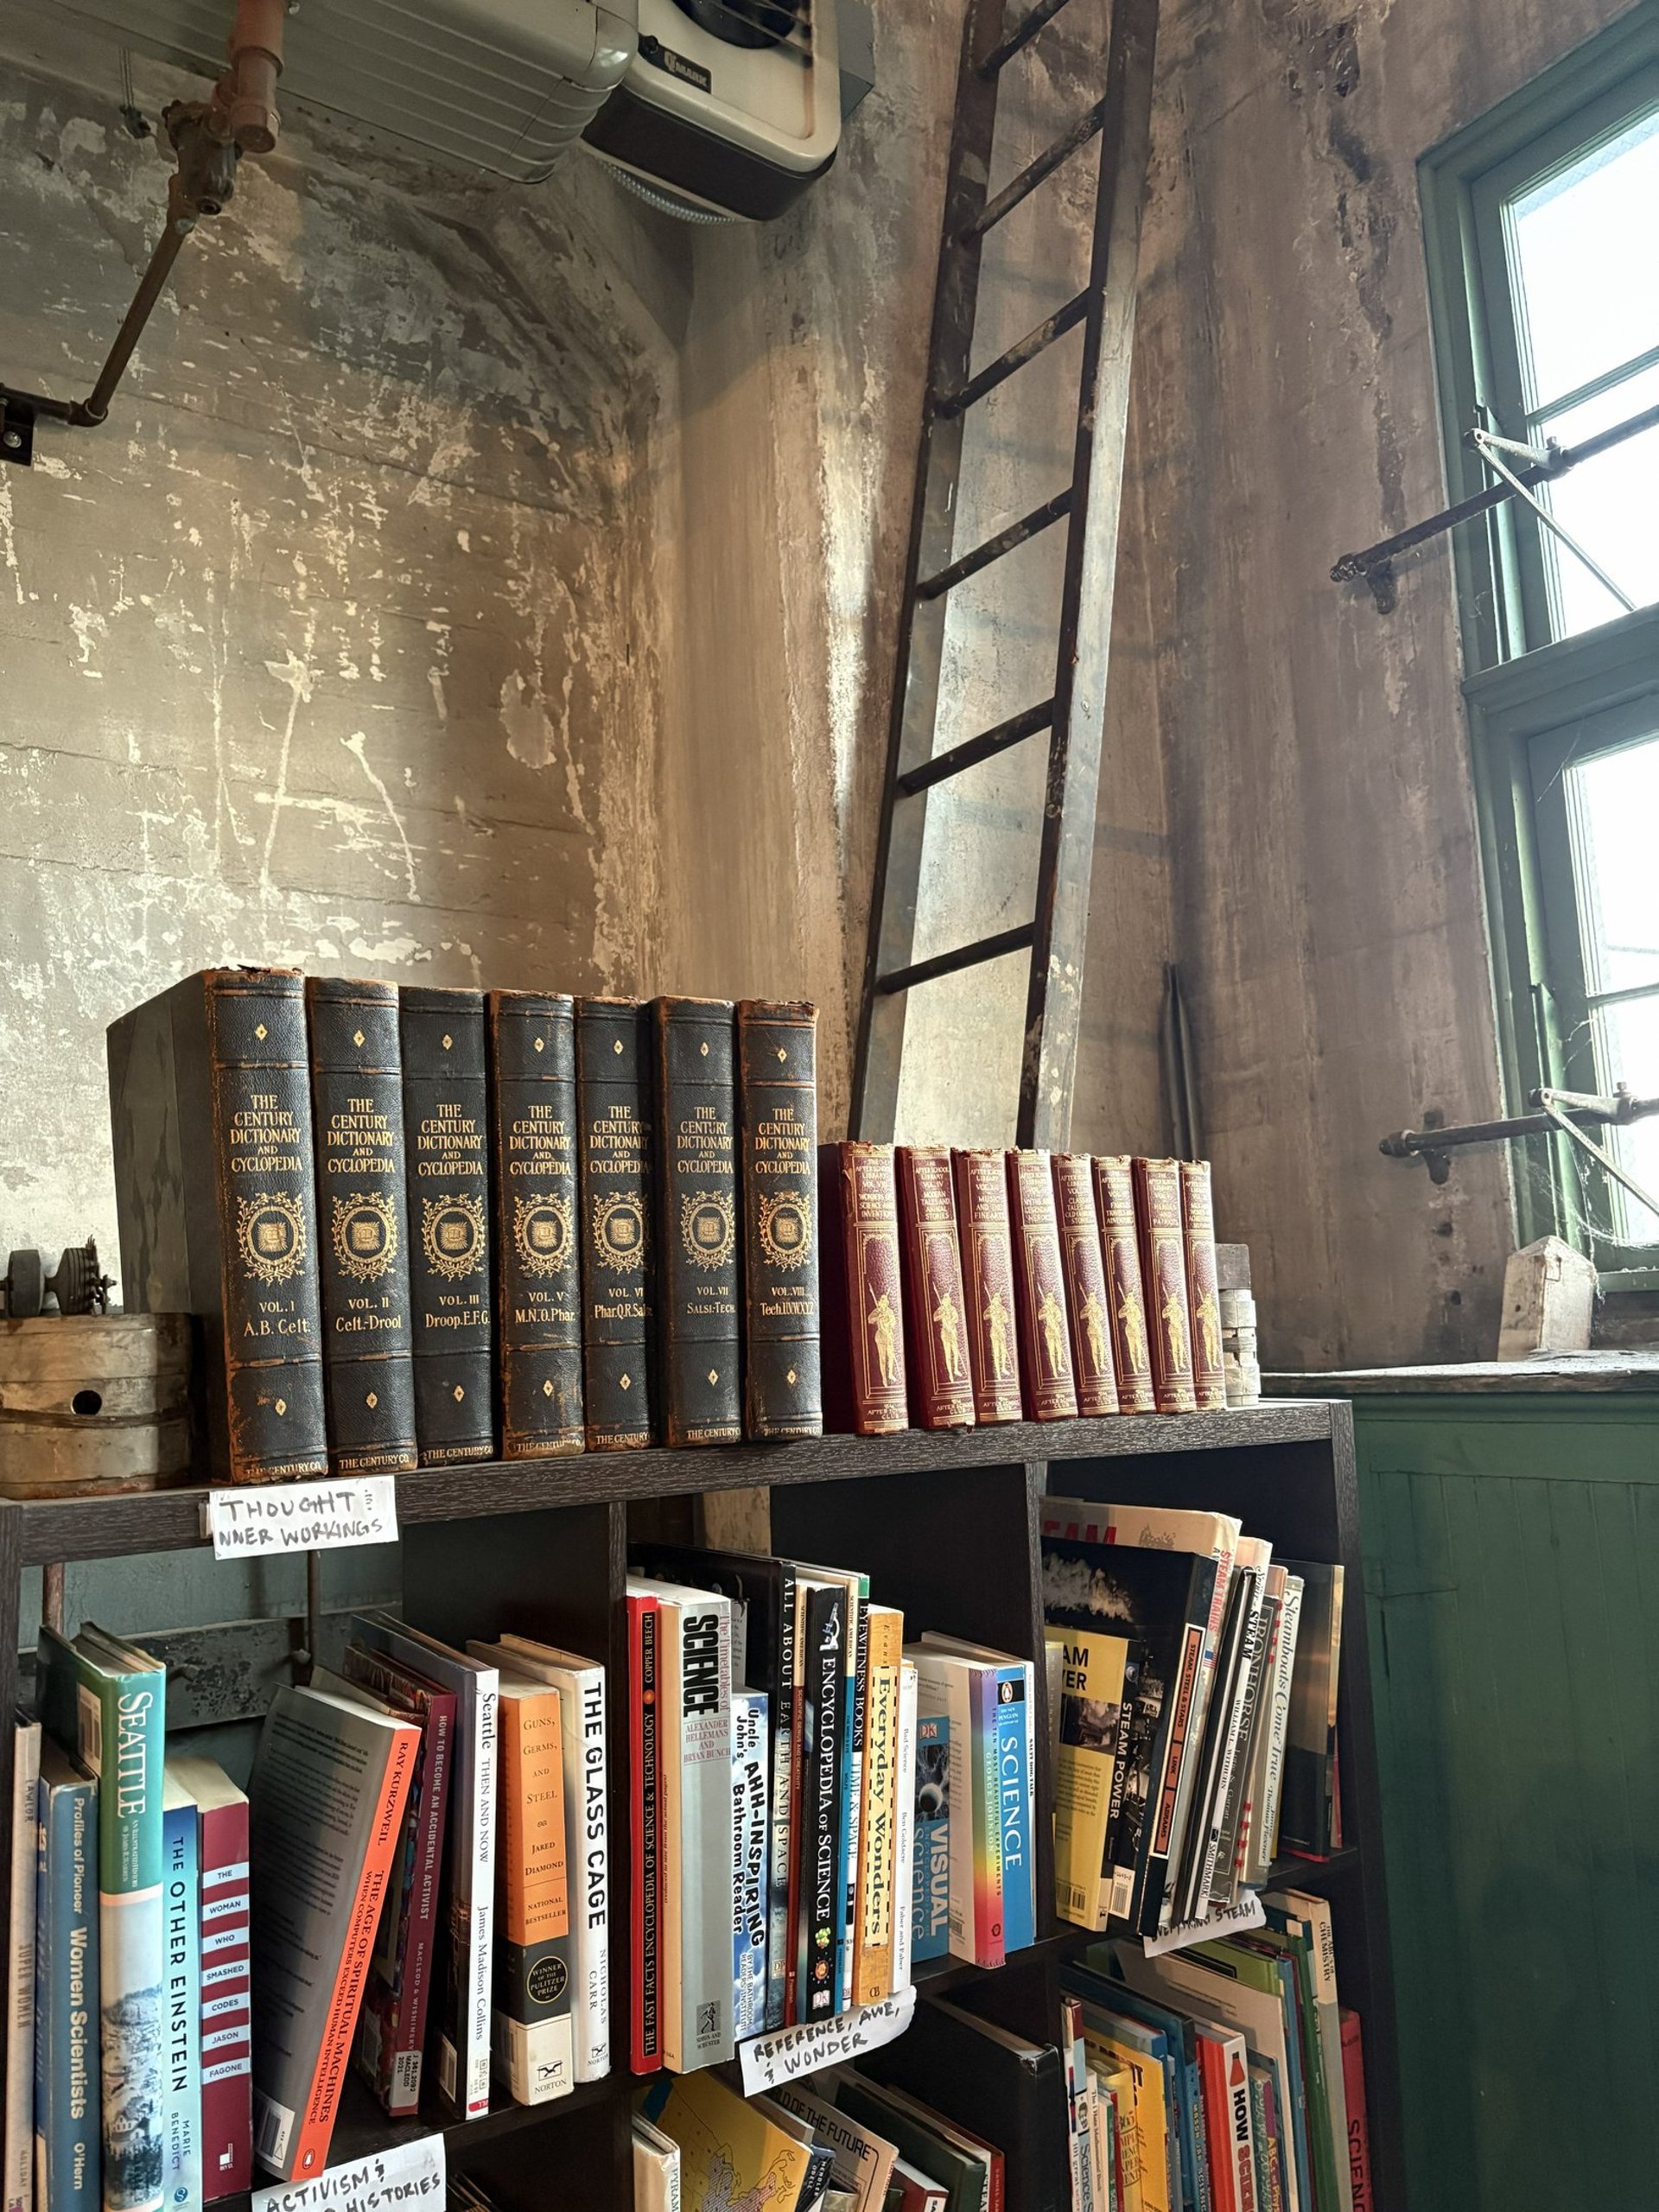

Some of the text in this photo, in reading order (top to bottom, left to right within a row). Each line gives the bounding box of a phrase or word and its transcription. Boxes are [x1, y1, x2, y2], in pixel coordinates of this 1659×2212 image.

[251, 1095, 278, 1109] THE
[347, 1099, 374, 1113] THE
[436, 1104, 461, 1118] THE
[529, 1105, 552, 1120] THE
[772, 1108, 794, 1121] THE
[234, 1111, 294, 1127] CENTURY
[331, 1114, 388, 1128] CENTURY
[421, 1119, 476, 1134] CENTURY
[513, 1121, 565, 1135] CENTURY
[758, 1122, 805, 1135] CENTURY
[230, 1128, 301, 1145] DICTIONARY
[327, 1130, 394, 1146] DICTIONARY
[416, 1135, 482, 1150] DICTIONARY
[509, 1135, 571, 1149] DICTIONARY
[755, 1136, 810, 1150] DICTIONARY
[257, 1145, 277, 1156] AND
[353, 1147, 373, 1156] AND
[442, 1151, 461, 1160] AND
[231, 1156, 303, 1173] CYCLOPEDIA
[327, 1157, 395, 1173] CYCLOPEDIA
[417, 1160, 483, 1176] CYCLOPEDIA
[509, 1160, 571, 1175] CYCLOPEDIA
[755, 1160, 810, 1175] CYCLOPEDIA
[219, 1491, 355, 1522] THOUGHT
[280, 1518, 383, 1547] WORKINGS
[1208, 1548, 1231, 1633] STEAM TRAINS
[1242, 1609, 1260, 1660] STEAM
[645, 1614, 653, 1683] COPPER BEECH
[683, 1613, 719, 1719] SCIENCE
[719, 1612, 731, 1713] The Timetables of
[854, 1605, 868, 1748] EYEWITNESS BOOKS
[1268, 1591, 1300, 1781] Steamboats Come True
[523, 1718, 556, 1731] GUNS,
[684, 1719, 728, 1733] ALEXANDER
[685, 1728, 728, 1744] HELLEMANS
[736, 1715, 747, 1758] John's
[747, 1708, 760, 1748] Uncle
[774, 1578, 794, 1888] ALL ABOUT EARTH AND SPACE
[117, 1691, 154, 1819] SEATTLE
[523, 1744, 557, 1756] GERMS,
[645, 1713, 654, 1788] TECHNOLOGY
[683, 1747, 731, 1763] BRYAN BUNCH
[698, 1740, 715, 1751] AND
[532, 1768, 550, 1777] AND
[1109, 1701, 1132, 1819] STEAM POWER
[1170, 1756, 1179, 1774] LINK
[480, 1693, 497, 1863] Seattle THEN AND NOW
[816, 1657, 836, 1922] ENCYCLOPEDIA OF SCIENCE
[378, 1742, 408, 1846] RAY KURZWEIL
[526, 1791, 557, 1805] STEEL
[584, 1682, 606, 1929] THE GLASS CAGE
[871, 1678, 890, 1934] Everyday Wonders
[1001, 1736, 1022, 1871] SCIENCE
[420, 1715, 448, 1920] HOW TO BECOME AN ACCIDENTAL ACTIVIST
[645, 1802, 654, 1852] SCIENCE
[1160, 1802, 1170, 1838] ABRAMS
[531, 1841, 556, 1854] JARED
[733, 1783, 747, 1934] Bathroom Reader
[744, 1760, 766, 1948] AHH-INSPIRING
[217, 1869, 232, 1878] THE
[524, 1860, 563, 1876] DIAMOND
[645, 1853, 655, 1869] OF
[1200, 1842, 1217, 1897] SMITHMARK
[912, 1827, 925, 1942] science
[931, 1823, 948, 1936] VISUAL
[209, 1900, 241, 1914] WOMAN
[527, 1897, 563, 1911] NATIONAL
[645, 1872, 655, 1957] ENCYCLOPEDIA
[1215, 1899, 1255, 1923] STEAM
[525, 1910, 566, 1925] BESTSELLER
[214, 1934, 235, 1945] WHO
[1319, 1922, 1331, 1982] CHEMISTRY
[70, 1797, 88, 2120] Profiles of Pioneer Women Scientists
[169, 1837, 188, 2092] THE OTHER EINSTEIN
[532, 1963, 562, 1976] WINNER
[206, 1965, 245, 1980] SMASHED
[475, 1905, 488, 2041] James Madison Collins
[531, 1976, 565, 1991] PULITZER
[645, 1961, 655, 1998] FACTS
[16, 1944, 32, 2029] SUPER WOMEN
[308, 1871, 372, 2125] WHEN COMPUTERS EXCEED HUMAN INTELLIGENCE
[319, 1870, 384, 2123] THE AGE OF SPIRITUAL MACHINES
[537, 1986, 559, 1996] PRIZE
[589, 1970, 598, 2010] CARR
[211, 1998, 239, 2012] CODES
[645, 1999, 655, 2028] FAST
[211, 2031, 239, 2044] JASON
[645, 2028, 655, 2054] THE
[753, 2001, 900, 2064] REFERENCE, AWE,
[783, 2033, 868, 2074] WONDER
[209, 2063, 243, 2077] FAGONE
[534, 2079, 567, 2094] NORTON
[1234, 2088, 1249, 2142] HOW
[171, 2112, 180, 2171] BENEDICT
[182, 2120, 191, 2158] MARIE
[827, 2121, 872, 2162] FUTURE
[73, 2142, 86, 2190] O'Hern
[266, 2166, 370, 2212] ACTIVISM
[346, 2172, 441, 2212] HISTORIES
